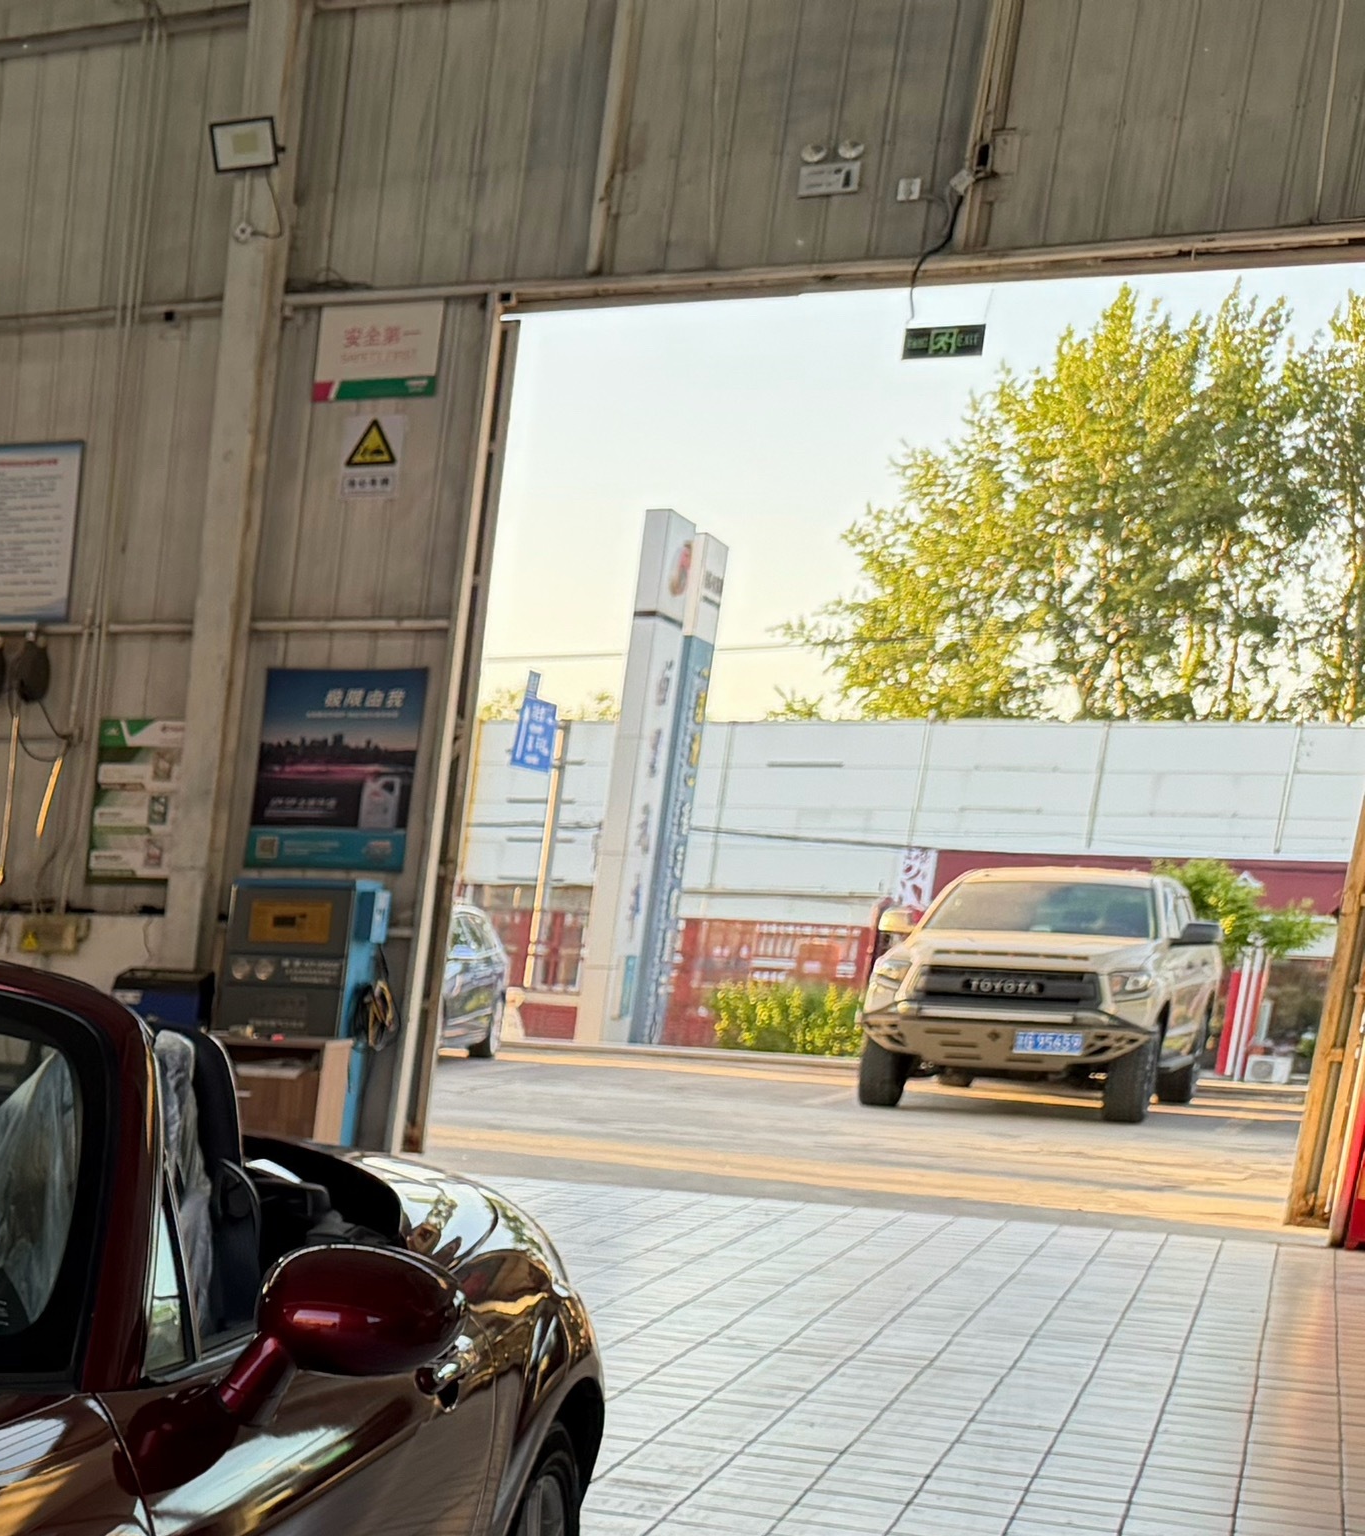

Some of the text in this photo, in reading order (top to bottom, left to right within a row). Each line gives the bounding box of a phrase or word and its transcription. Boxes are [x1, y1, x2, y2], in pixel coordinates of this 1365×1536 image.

[343, 325, 422, 348] 安全第一
[970, 979, 1040, 995] TOYOTA
